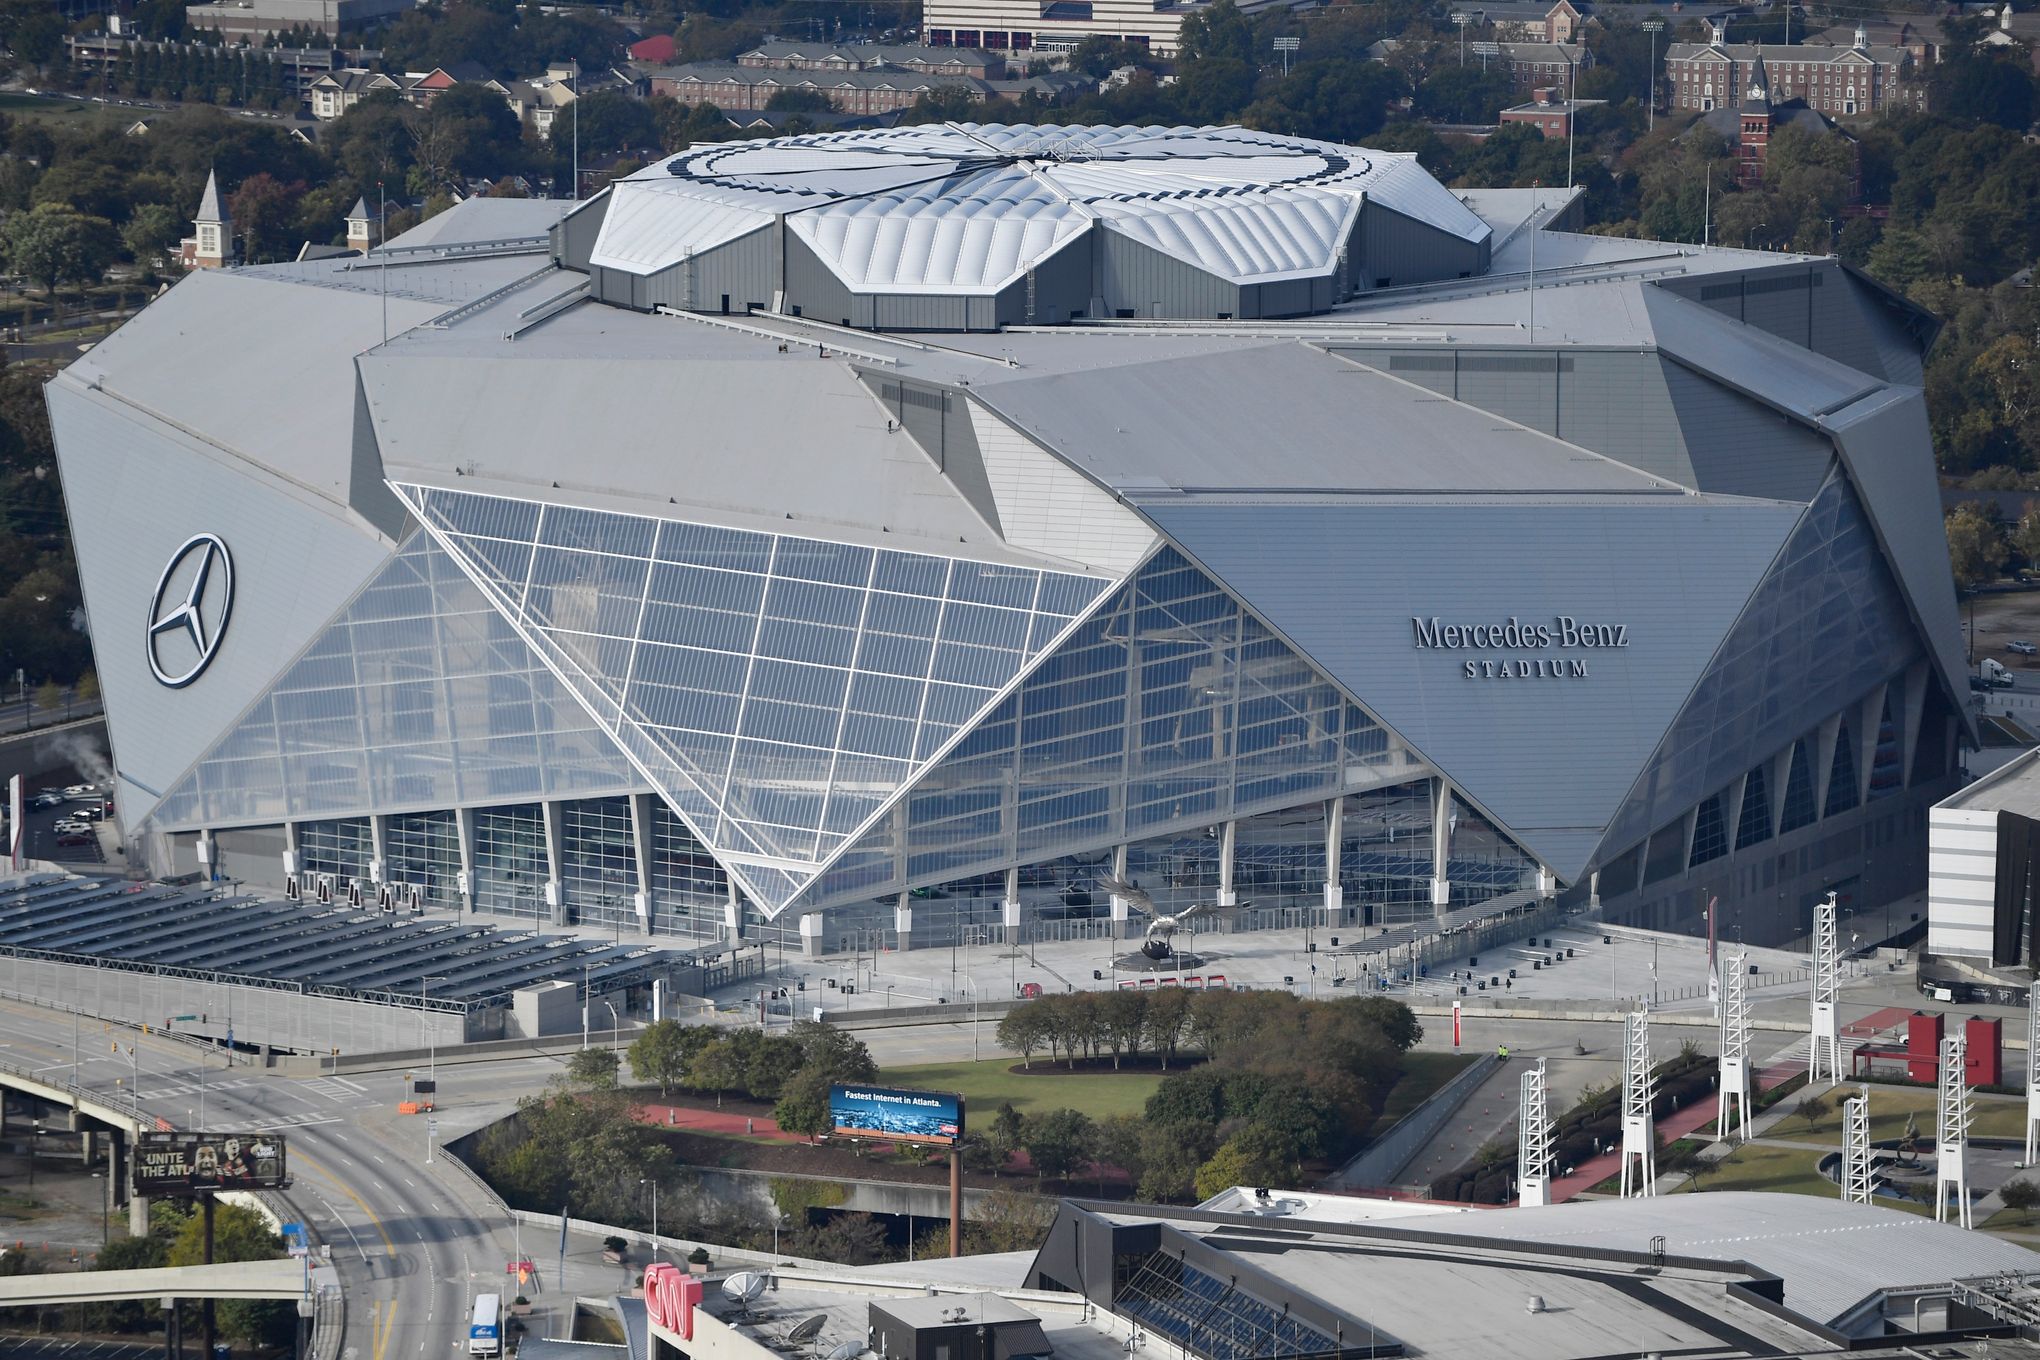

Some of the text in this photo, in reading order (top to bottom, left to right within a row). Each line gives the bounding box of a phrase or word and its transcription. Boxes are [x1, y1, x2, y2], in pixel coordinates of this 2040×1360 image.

[1411, 616, 1630, 649] Mercedes-Benz
[1464, 659, 1589, 678] STADIUM
[844, 1090, 942, 1108] Fastest Internet in Atlanta.
[146, 1152, 184, 1165] UNITE
[141, 1165, 166, 1177] THE
[644, 1262, 704, 1341] CNN
